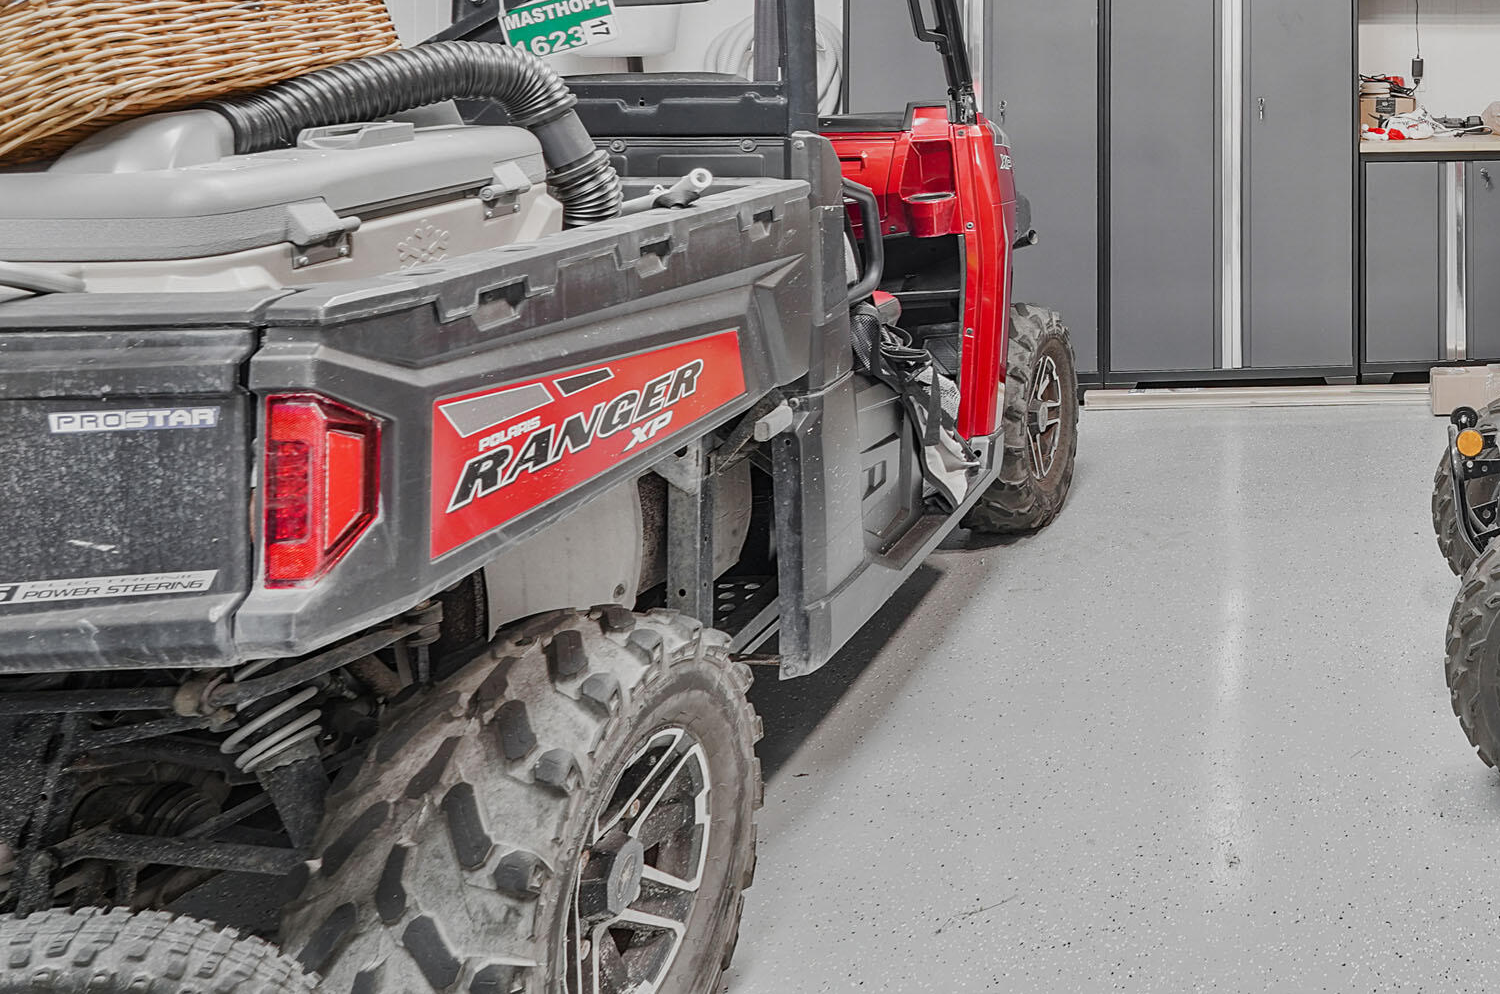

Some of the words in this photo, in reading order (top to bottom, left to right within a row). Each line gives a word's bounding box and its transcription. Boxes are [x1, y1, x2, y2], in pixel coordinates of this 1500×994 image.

[590, 20, 611, 36] 17
[55, 408, 217, 430] PROSTAR
[478, 415, 541, 452] POLARIS
[621, 410, 673, 453] XP
[445, 358, 704, 513] RANGER
[22, 585, 100, 600] POWER
[104, 579, 204, 596] STEERING
